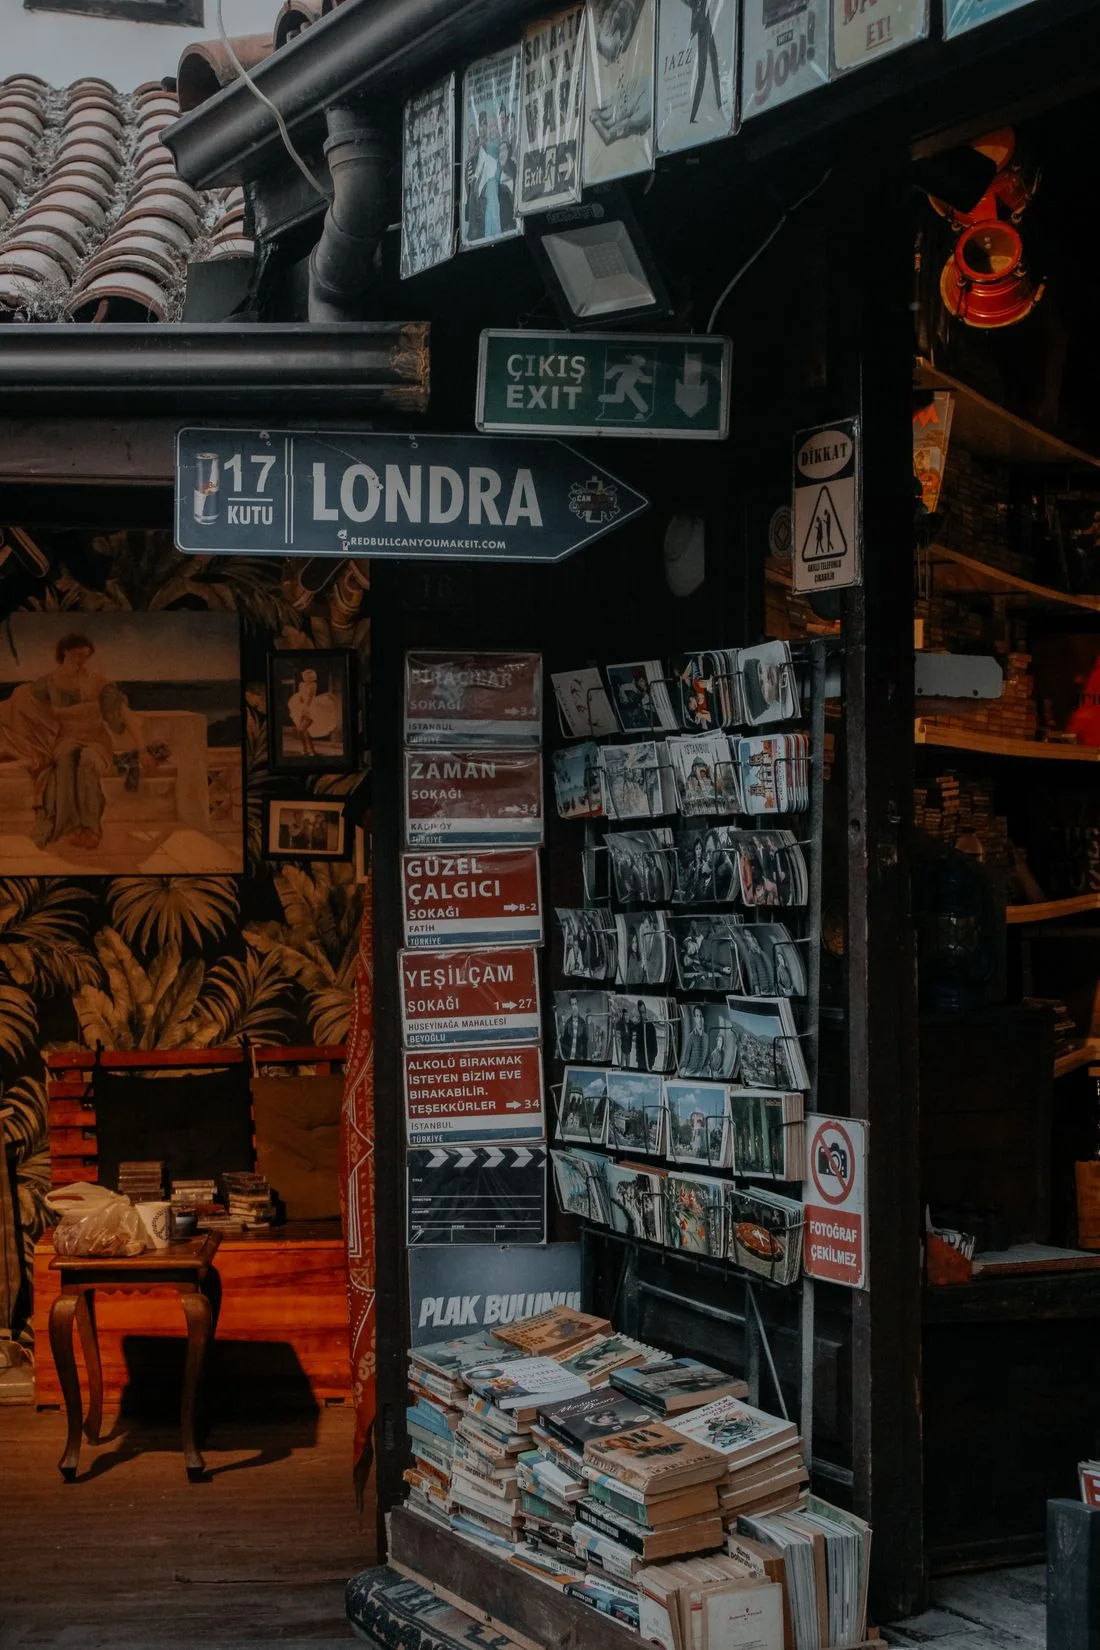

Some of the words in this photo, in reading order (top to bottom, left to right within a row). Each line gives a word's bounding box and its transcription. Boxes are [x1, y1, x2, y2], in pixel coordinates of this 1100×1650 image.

[664, 48, 692, 75] JAZZ
[523, 164, 542, 189] Exit
[507, 354, 586, 384] ÇIKIŞ
[507, 384, 583, 411] EXIT
[801, 443, 848, 467] DİKKAT
[223, 453, 277, 493] 17
[312, 462, 544, 527] LONDRA
[227, 505, 274, 525] KUTU
[350, 537, 507, 550] REDBULLCANYOUMAKEIT.COM
[410, 761, 497, 780] ZAMAN
[411, 785, 462, 800] SOKAĞI
[406, 856, 483, 878] GÜZEL
[408, 879, 501, 905] ÇALGICI
[409, 905, 460, 919] SOKAĞI
[409, 923, 435, 933] FATİH
[405, 964, 514, 990] YEŞİLÇAM
[407, 995, 459, 1013] SOKAĞI
[408, 1057, 456, 1071] ALKOLÜ
[459, 1055, 522, 1068] BIRAKMAK
[409, 1073, 458, 1085] İSTEYEN
[462, 1069, 496, 1081] BİZİM
[499, 1069, 521, 1080] EVE
[409, 1085, 489, 1100] BIRAKABİLİR.
[409, 1100, 497, 1115] TEŞEKKÜRLER
[524, 1099, 540, 1109] 34
[809, 1220, 858, 1242] FOTOĞRAF
[810, 1244, 857, 1267] ÇEKİLMEZ
[418, 1295, 481, 1329] PLAK
